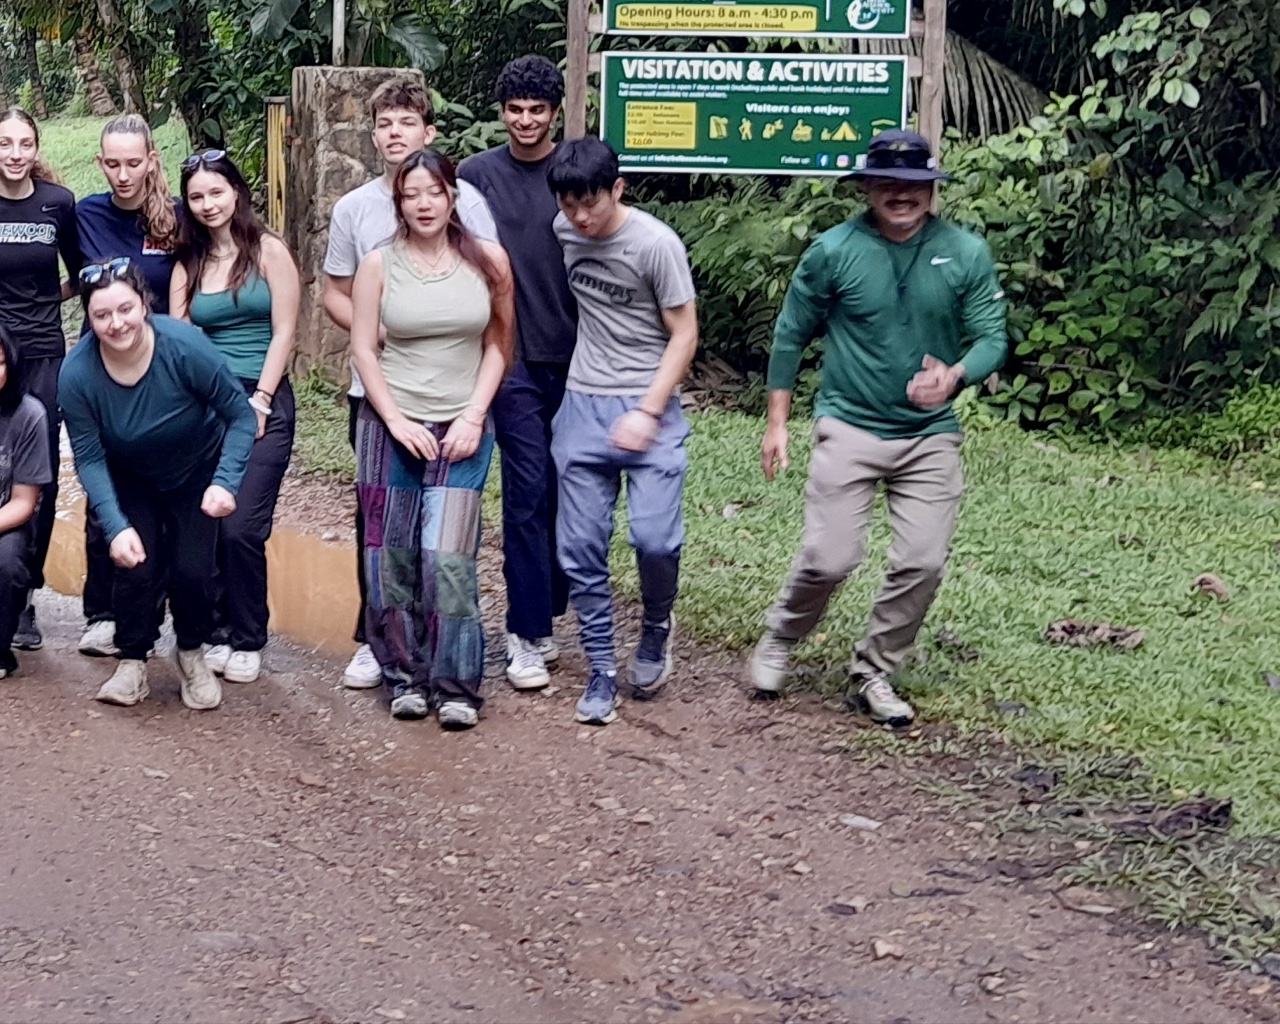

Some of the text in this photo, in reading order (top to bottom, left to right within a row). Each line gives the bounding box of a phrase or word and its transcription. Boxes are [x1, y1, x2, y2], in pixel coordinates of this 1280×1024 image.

[620, 5, 672, 19] Opening
[676, 6, 715, 17] Hours:
[719, 7, 726, 17] 8
[729, 9, 751, 18] a.m
[761, 8, 787, 19] 4:30
[791, 10, 814, 21] p.m
[622, 59, 889, 83] VISITATION & ACTIVITIES
[746, 103, 789, 113] Visitors
[813, 105, 850, 116] enjoy:
